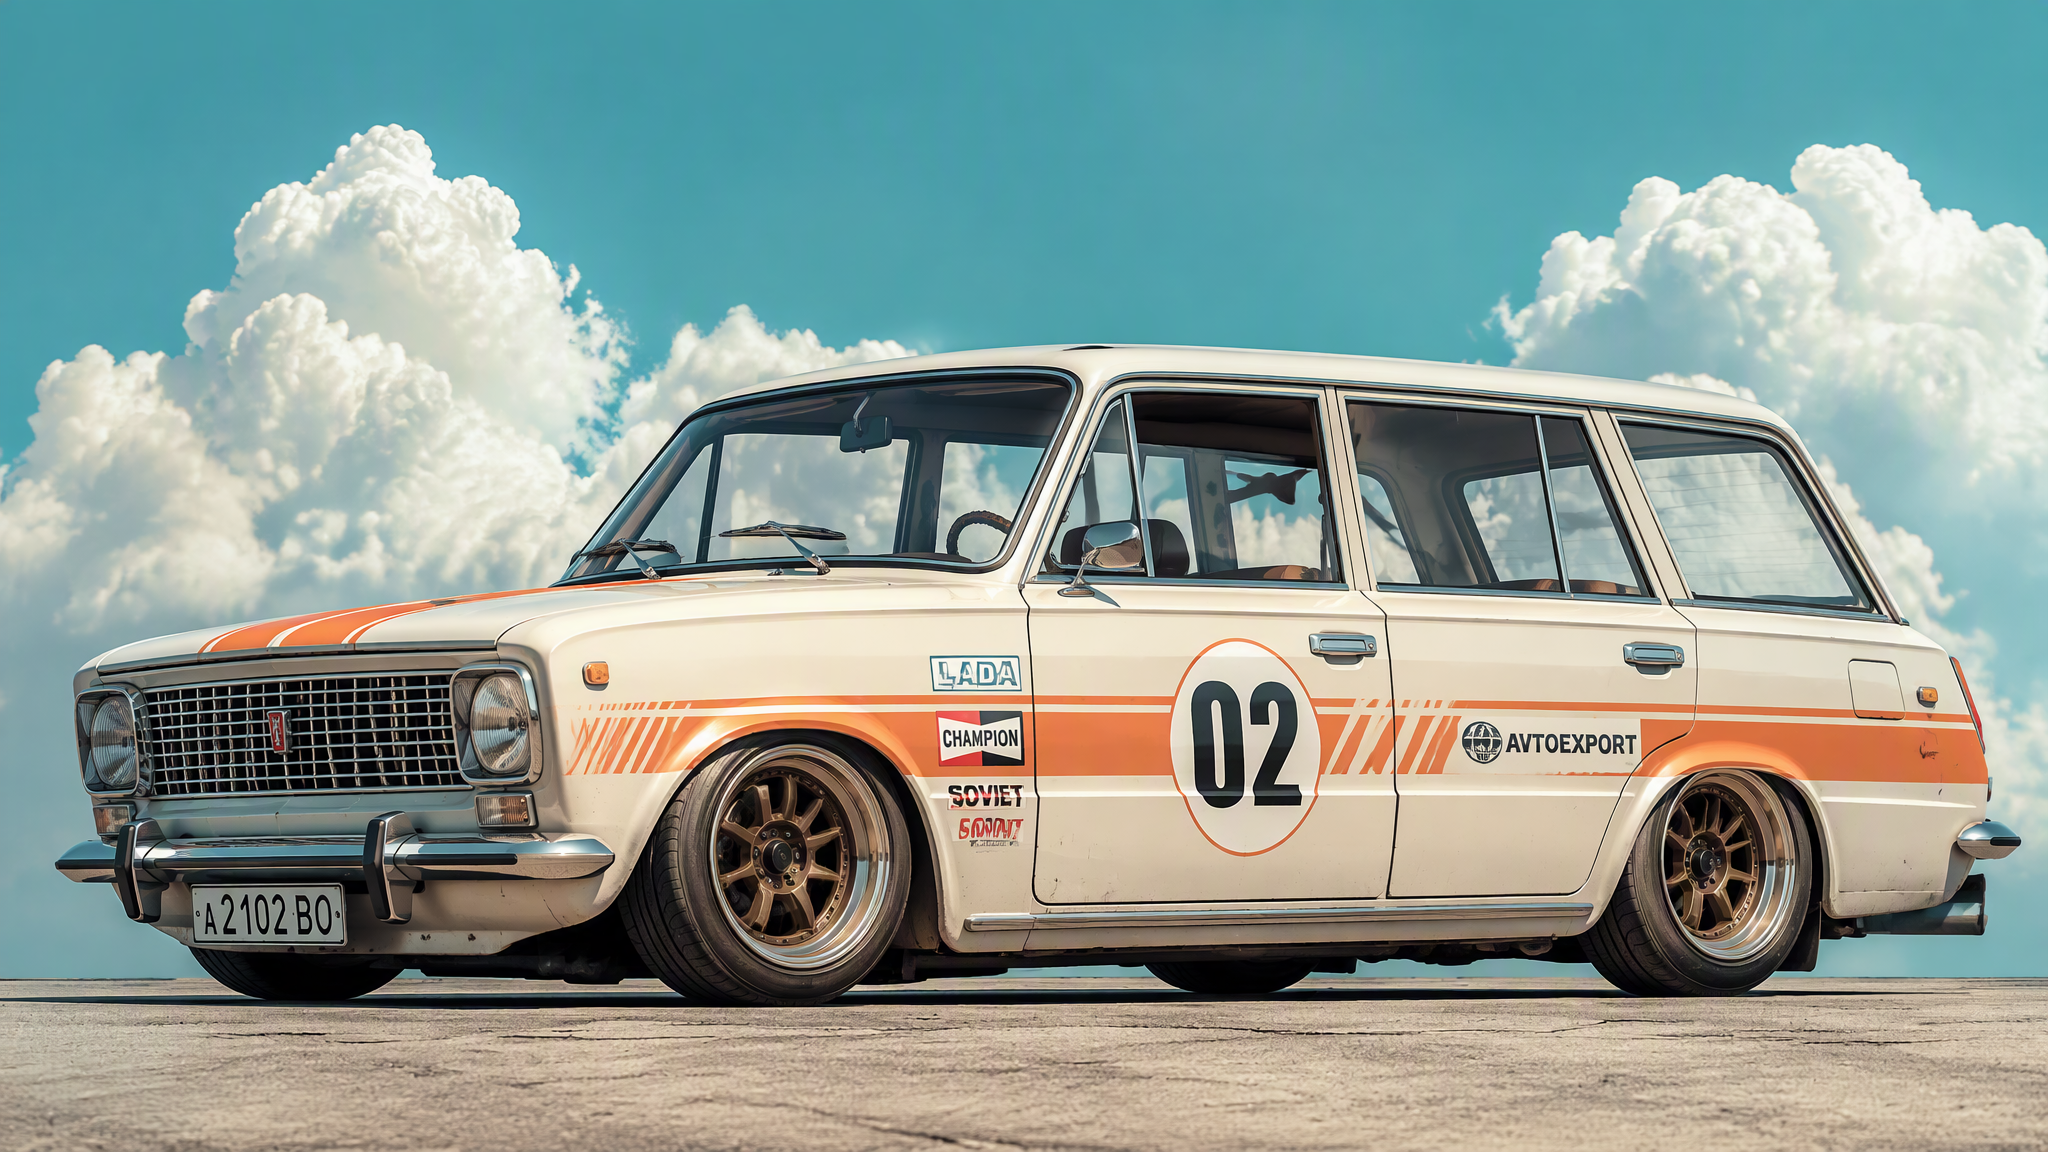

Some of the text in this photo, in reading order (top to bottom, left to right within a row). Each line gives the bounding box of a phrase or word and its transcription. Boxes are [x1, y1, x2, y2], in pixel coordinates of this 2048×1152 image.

[938, 661, 1018, 687] LADA
[942, 729, 1019, 748] CHAMPION
[1191, 680, 1302, 809] 02
[1505, 733, 1637, 755] AVTOEXPORT
[948, 784, 1024, 808] SOVIET
